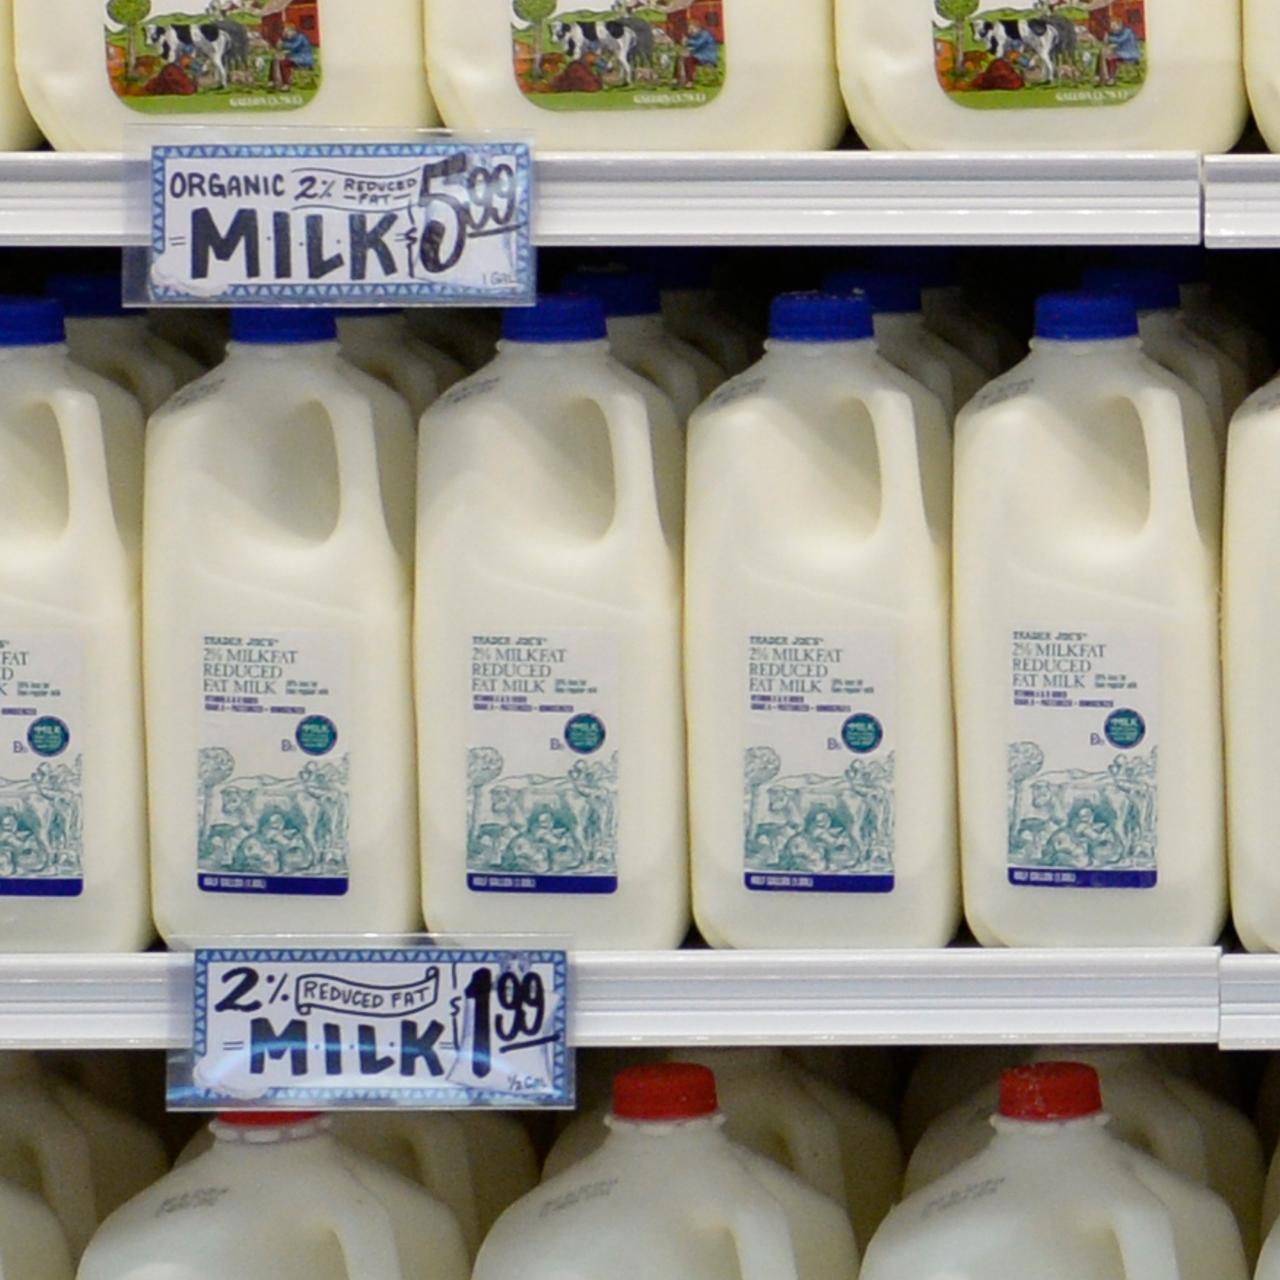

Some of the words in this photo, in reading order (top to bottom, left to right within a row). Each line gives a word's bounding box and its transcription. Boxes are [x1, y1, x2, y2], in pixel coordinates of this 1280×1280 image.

[169, 172, 286, 199] ORGANIC
[293, 175, 336, 201] 2%
[343, 178, 417, 192] REDUCED
[226, 650, 298, 664] MILKFAT
[203, 664, 282, 679] REDUCED
[203, 679, 231, 693] FAT
[234, 680, 277, 695] MILK
[214, 967, 290, 1013] 2%
[303, 980, 384, 1010] REDUCED
[391, 986, 431, 1008] FAT
